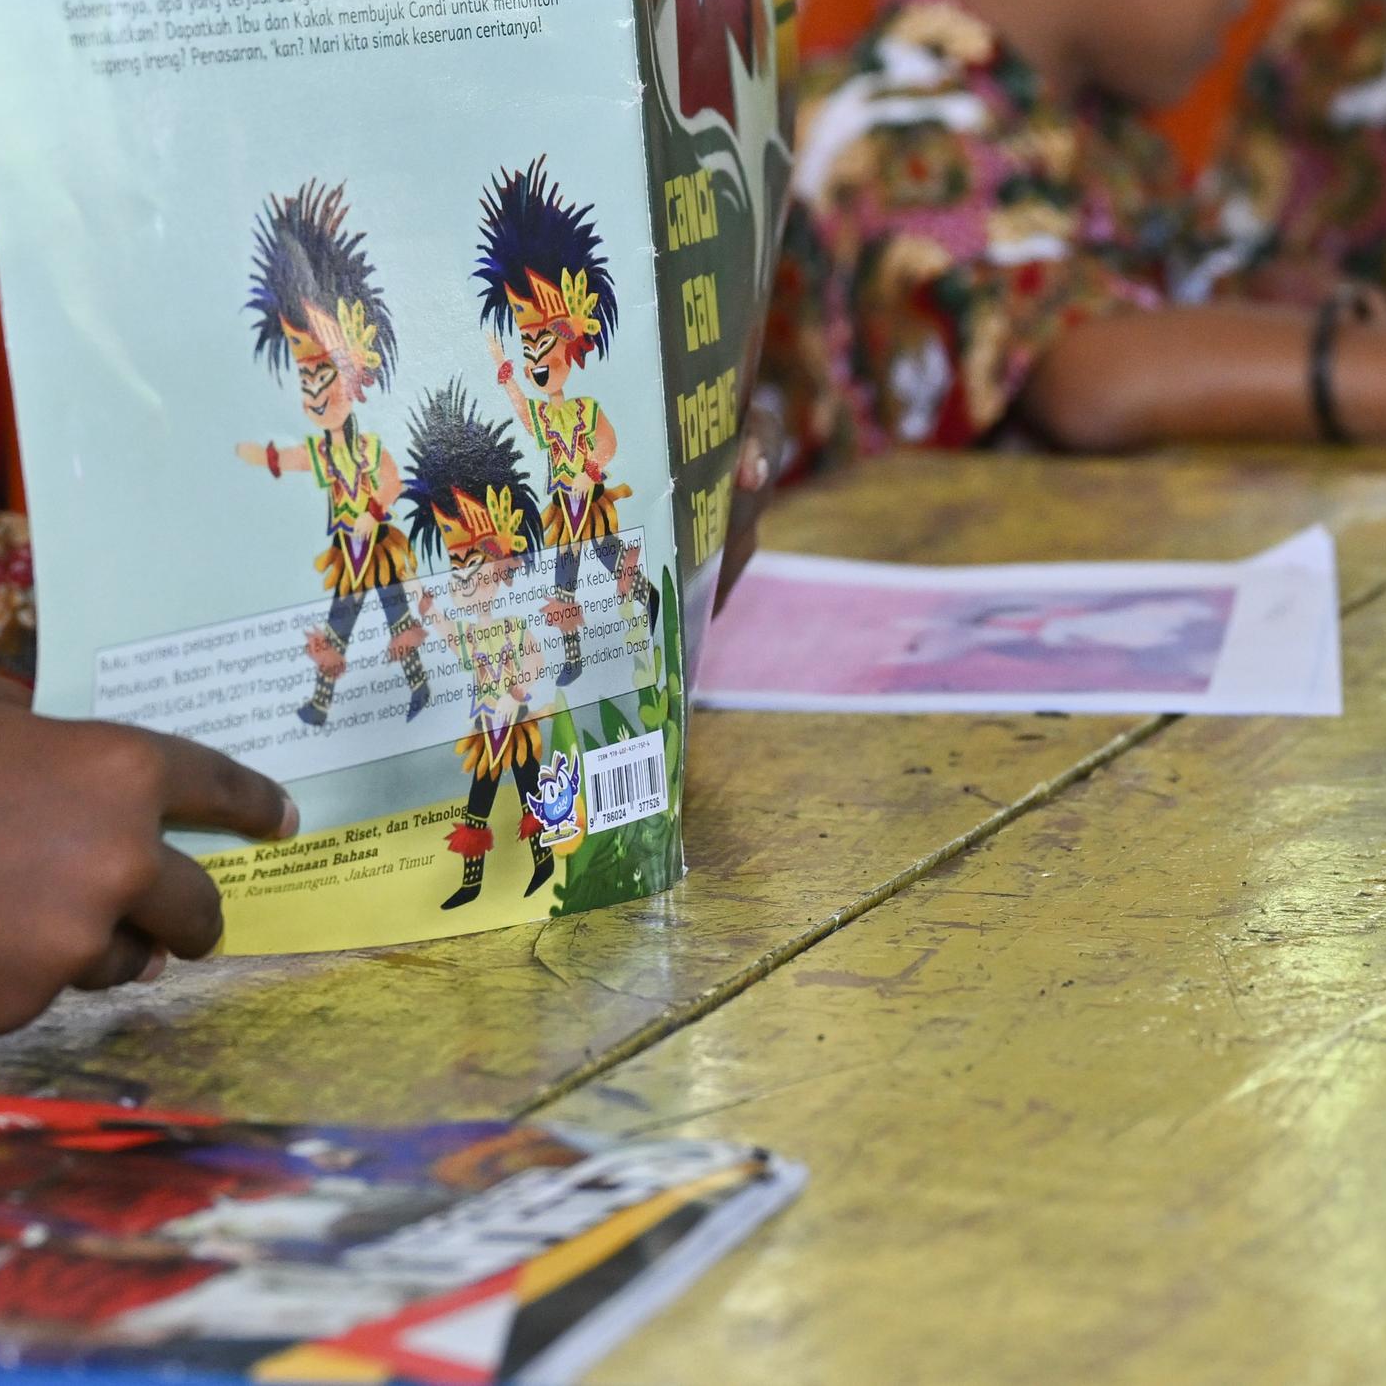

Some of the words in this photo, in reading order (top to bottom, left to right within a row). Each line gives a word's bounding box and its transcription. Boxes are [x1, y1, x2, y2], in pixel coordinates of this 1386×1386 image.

[165, 19, 233, 44] Dapatkah
[236, 14, 261, 34] Ibu
[265, 12, 290, 32] dan
[293, 8, 334, 29] Kakak
[338, 4, 405, 27] membujuk
[191, 46, 268, 67] Penasaran,
[310, 34, 340, 56] Mari
[344, 32, 369, 52] kita
[372, 28, 411, 50] simak
[413, 25, 473, 46] keseruan
[476, 16, 543, 39] ceritanya!
[677, 368, 737, 464] TOPENG
[258, 616, 288, 637] telah
[422, 575, 475, 600] Keputusan
[477, 564, 527, 586] Pelaksana
[583, 544, 617, 562] Kepala
[617, 535, 643, 556] Pusat
[358, 625, 380, 642] dan
[443, 597, 507, 621] Kementerian
[509, 582, 563, 605] Pendidikan
[564, 577, 585, 593] dan
[587, 563, 645, 589] Kebudayaan
[447, 624, 504, 648] Penetapan
[504, 617, 527, 635] Buku
[527, 604, 584, 628] Pengayaan
[477, 644, 517, 669] sebagai
[519, 640, 542, 658] Buku
[583, 618, 625, 640] Pelajaran
[626, 612, 649, 632] yang
[276, 725, 308, 745] untuk
[467, 679, 500, 698] Belajar
[503, 672, 531, 691] pada
[626, 638, 651, 656] Dasar
[253, 835, 341, 865] Kebudayaan,
[345, 826, 382, 845] Riset,
[386, 820, 409, 835] dan
[413, 803, 471, 827] Teknolog
[589, 817, 594, 828] 9
[602, 807, 627, 824] 786024
[638, 796, 661, 813] 377526
[219, 869, 246, 886] dan
[251, 857, 328, 882] Pembinaan
[332, 846, 380, 866] Bahasa
[344, 863, 395, 884] Jakarta
[398, 853, 436, 872] Timur
